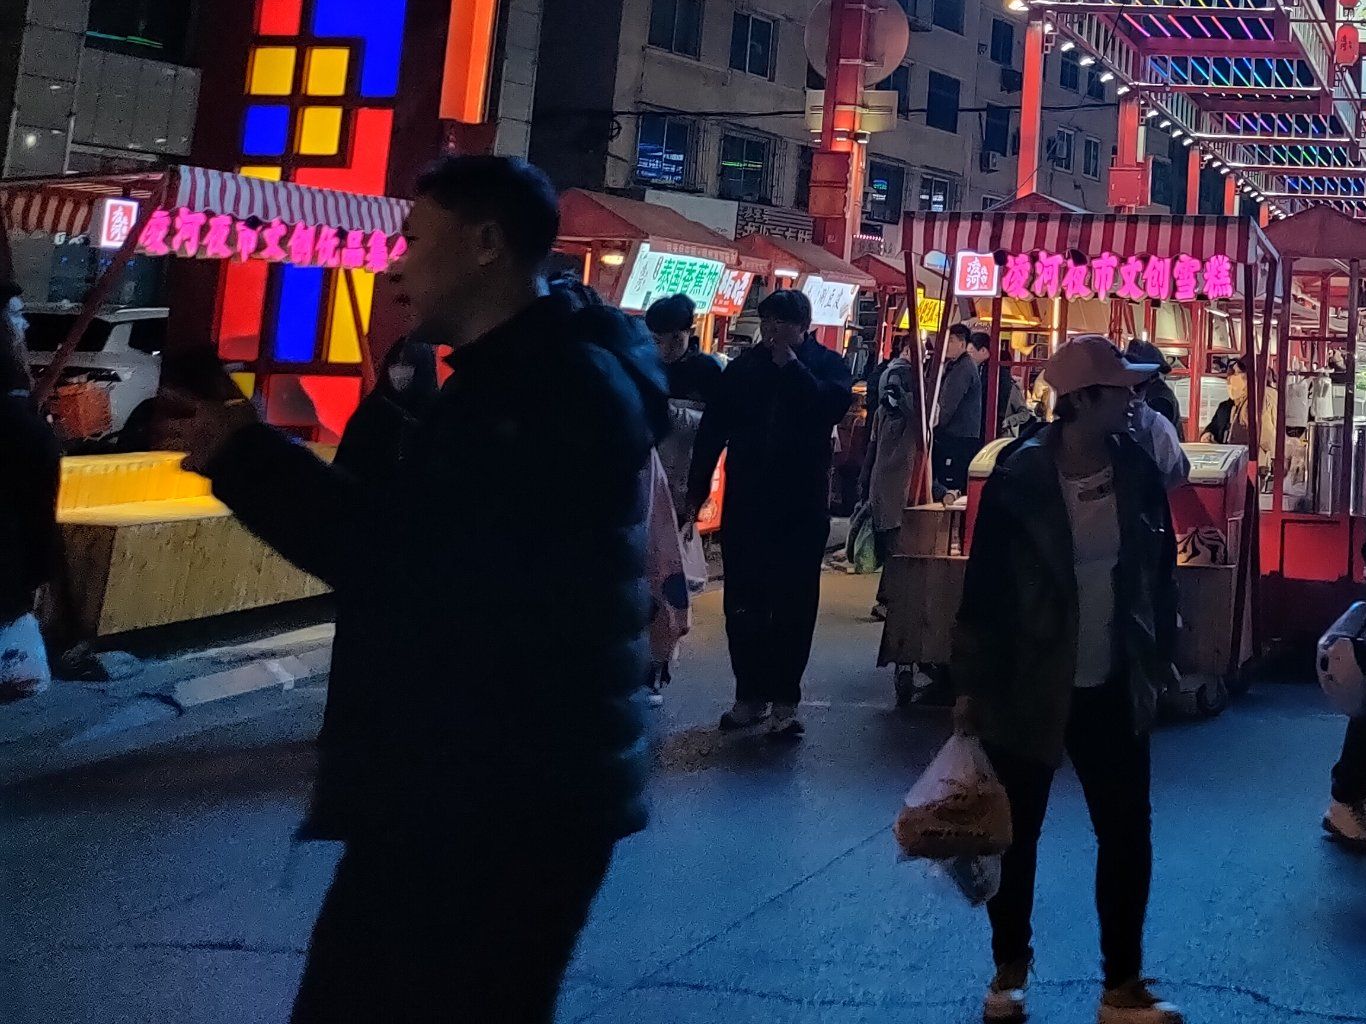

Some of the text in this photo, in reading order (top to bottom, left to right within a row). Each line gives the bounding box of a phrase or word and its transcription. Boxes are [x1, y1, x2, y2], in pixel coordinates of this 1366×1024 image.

[1001, 250, 1236, 301] 凌河夜市文创雪糕
